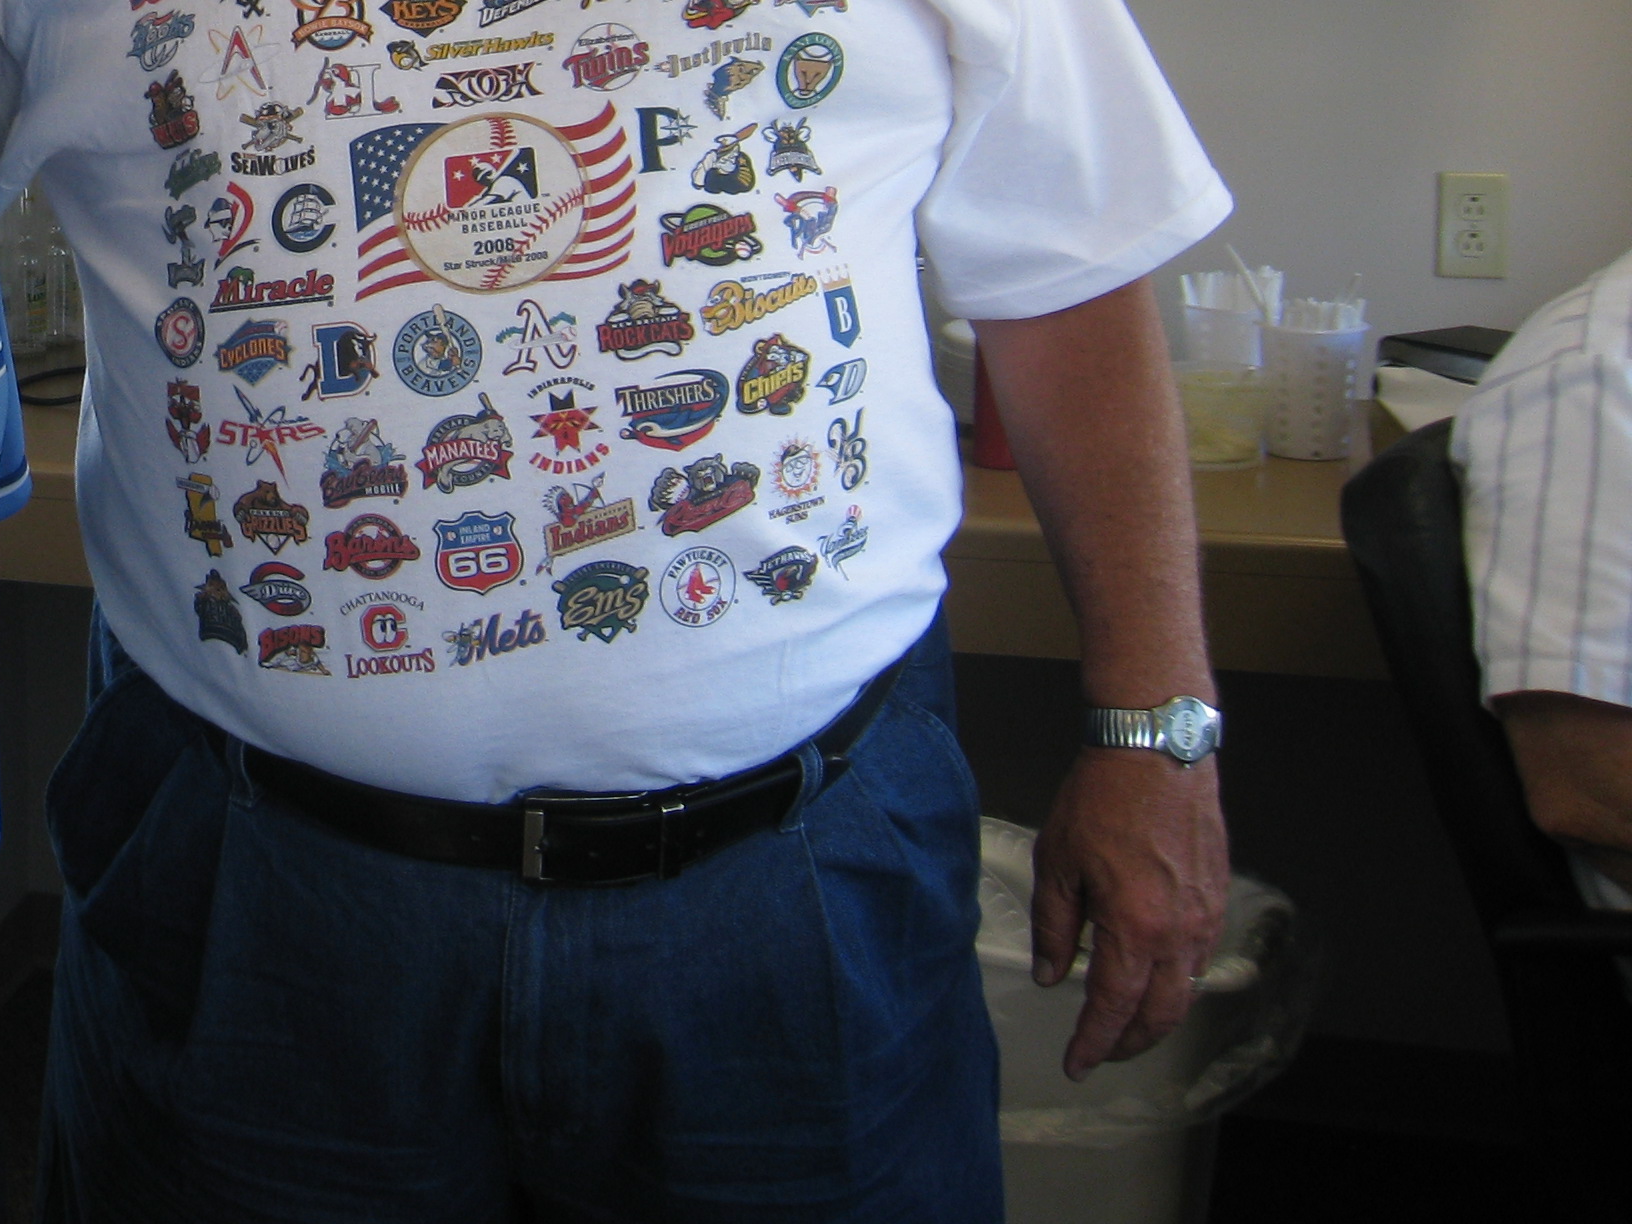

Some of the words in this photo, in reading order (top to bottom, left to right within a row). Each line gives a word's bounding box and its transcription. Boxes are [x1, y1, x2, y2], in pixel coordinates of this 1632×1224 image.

[562, 41, 650, 88] Twins
[448, 210, 487, 223] MINOR
[491, 203, 541, 218] LEAGUE
[462, 218, 528, 234] BASEBALL
[474, 237, 515, 256] 2008
[443, 261, 462, 271] Star
[211, 269, 335, 307] Miracle
[700, 273, 818, 335] Biscuits
[834, 296, 853, 333] B
[398, 315, 477, 353] PORTLAND
[599, 323, 648, 353] ROCK
[649, 314, 693, 340] CATS
[220, 339, 285, 368] CYCLONES
[401, 359, 476, 392] BEAVERS
[527, 376, 597, 399] INDIANAPOLIS
[743, 362, 804, 405] Chiefs
[618, 378, 716, 414] THRESHERS
[216, 420, 326, 447] STARS
[426, 439, 501, 471] MANATEES
[528, 443, 610, 474] INDIANS
[365, 482, 401, 495] MOBILE
[549, 510, 629, 551] Indians
[323, 531, 421, 571] Barons
[448, 547, 510, 578] 66
[340, 591, 425, 616] CHATTANOOGA
[564, 581, 648, 626] Ems
[673, 606, 702, 624] RED
[706, 595, 729, 622] SOX
[259, 624, 325, 663] BISONS
[361, 604, 409, 652] C
[457, 608, 547, 666] Mets
[344, 648, 435, 678] LOOKOUTS
